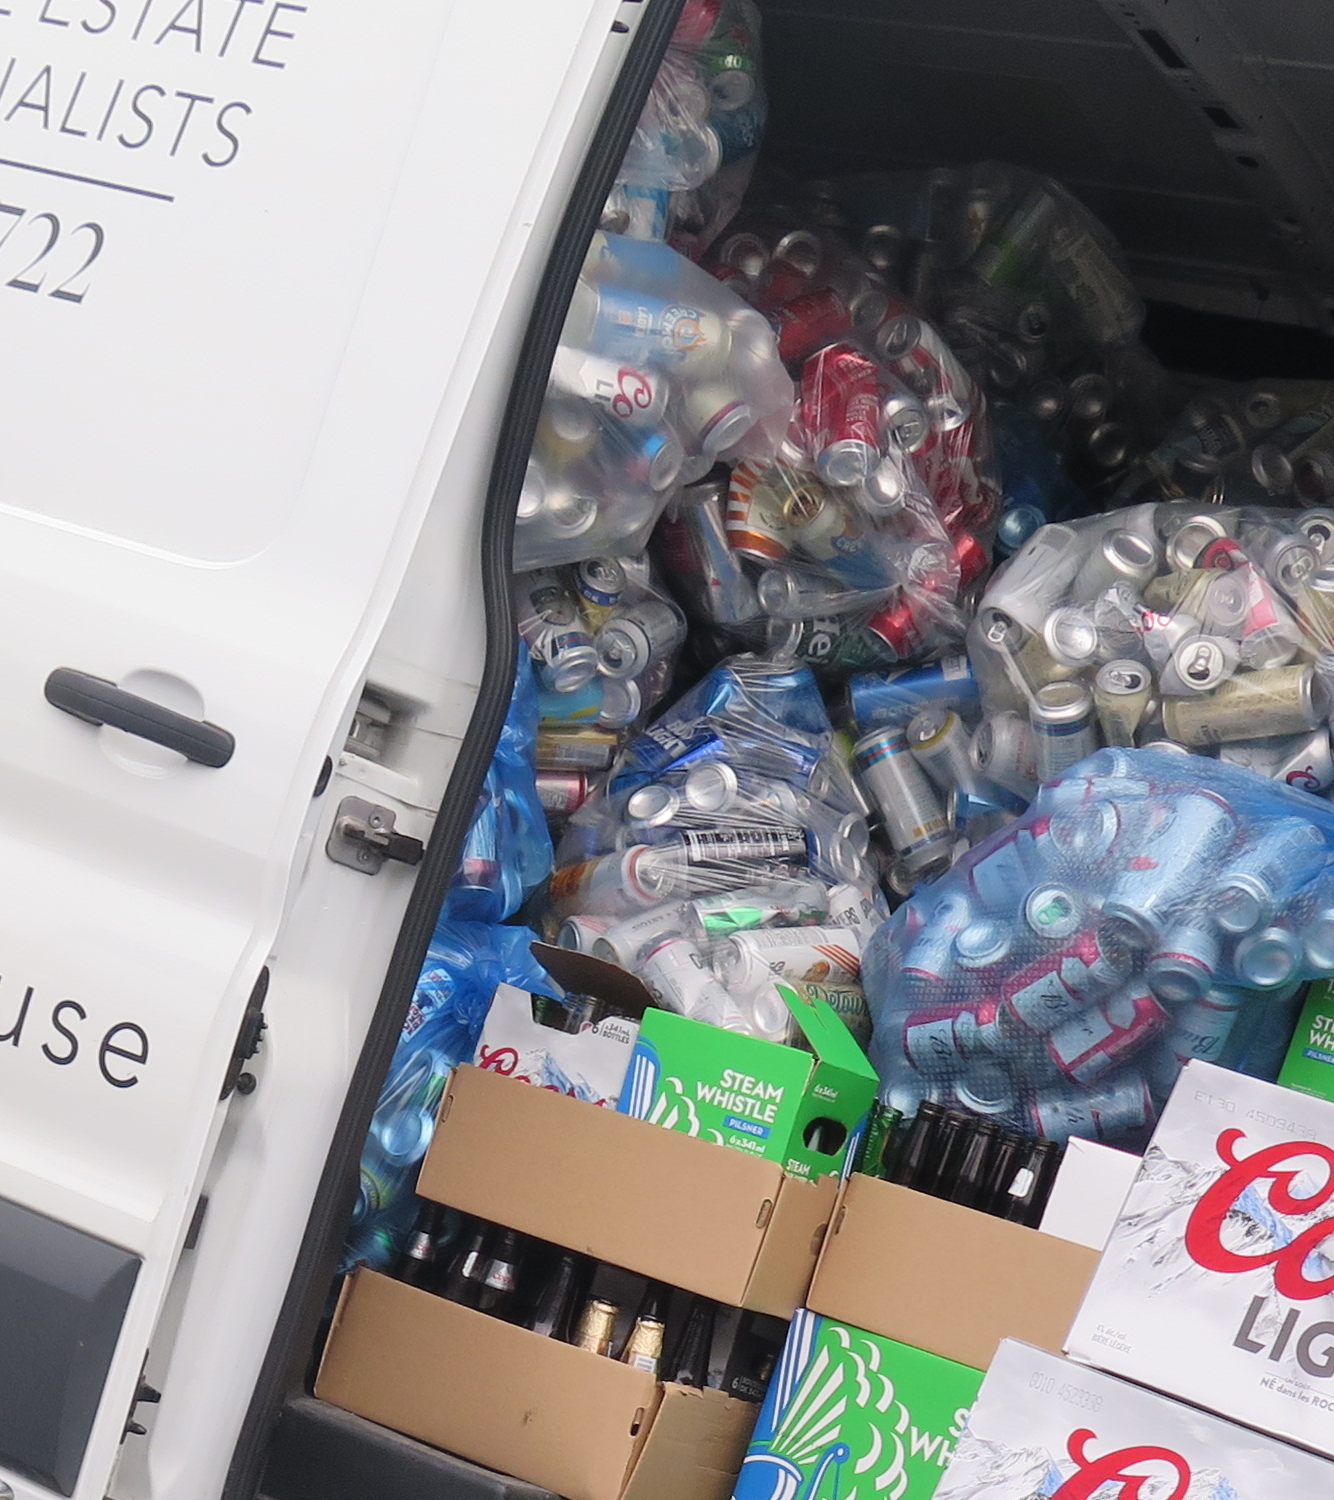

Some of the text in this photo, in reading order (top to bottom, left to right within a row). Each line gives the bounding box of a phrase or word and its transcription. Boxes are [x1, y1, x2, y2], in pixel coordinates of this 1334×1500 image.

[719, 1068, 785, 1104] STEAM
[696, 1080, 778, 1124] WHISTLE
[728, 1117, 764, 1137] PILSNER
[1276, 1384, 1296, 1399] dans
[1297, 1390, 1311, 1404] les
